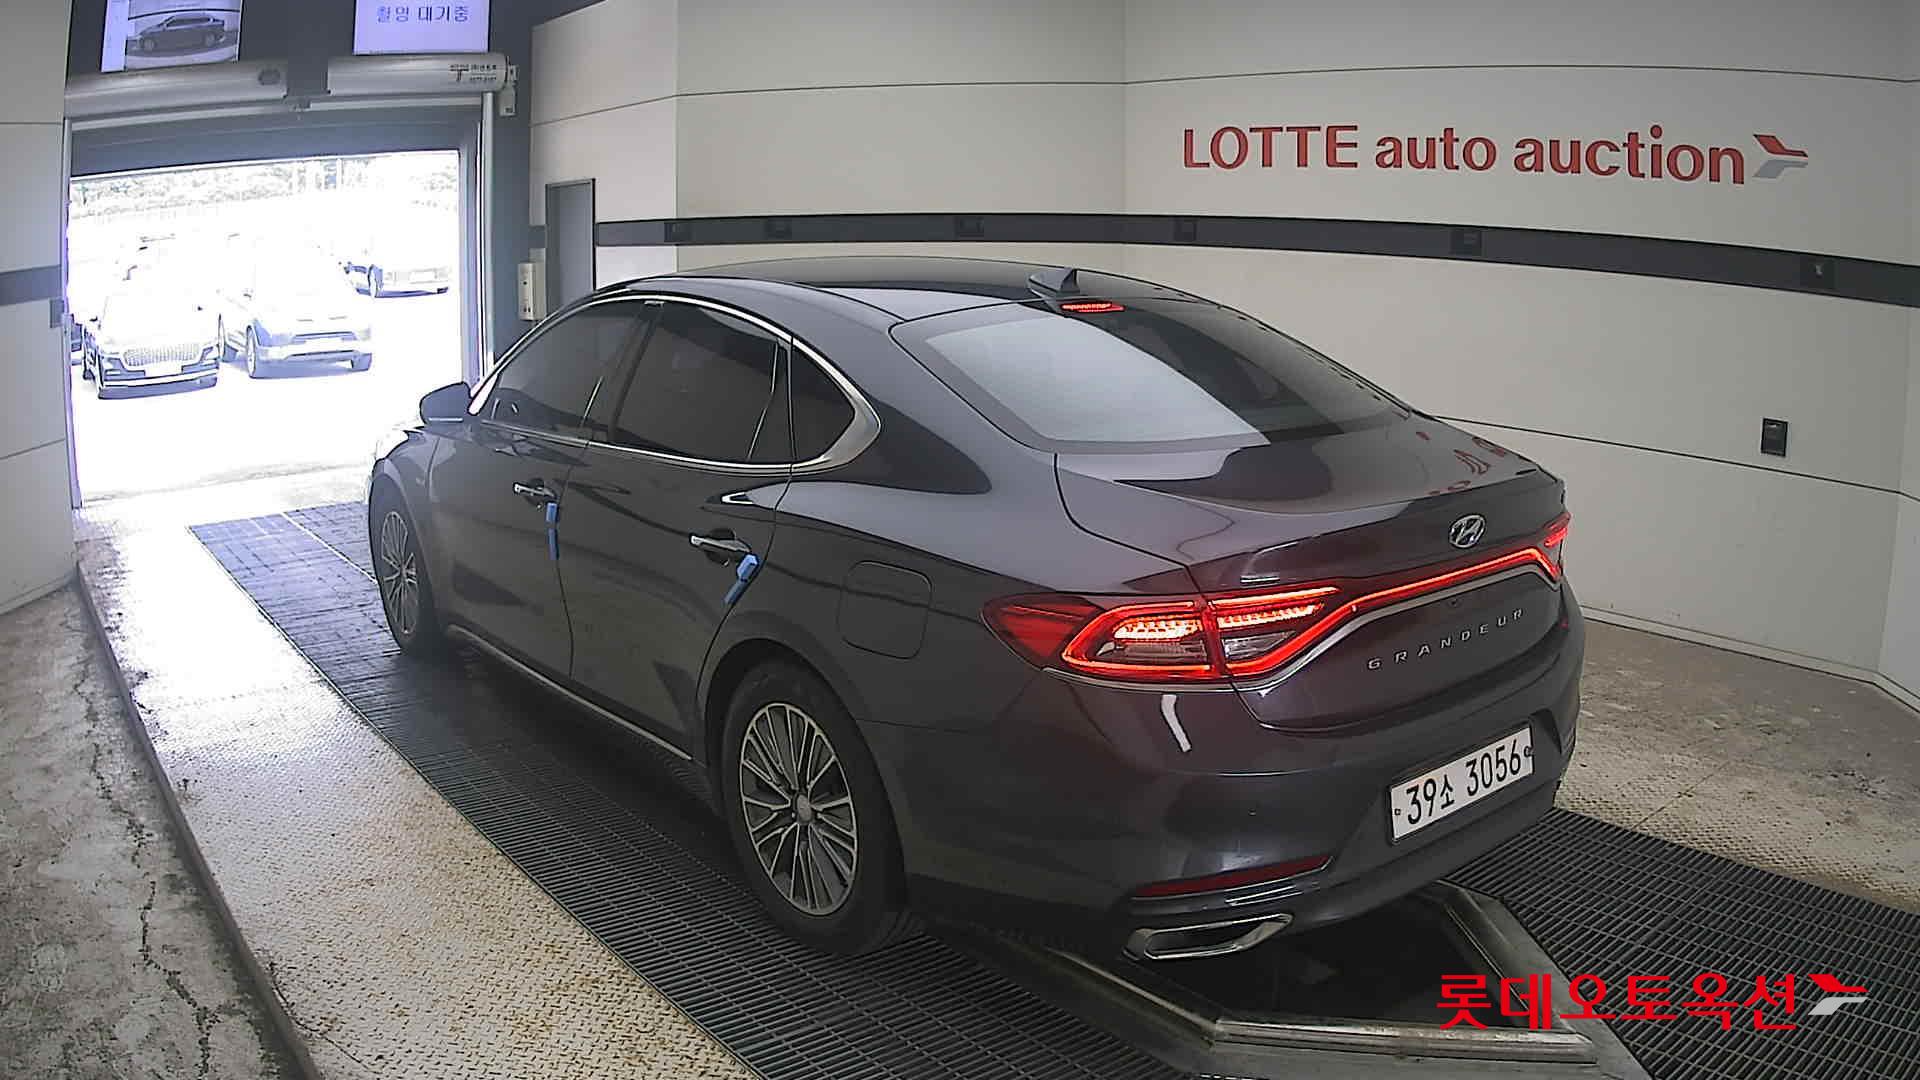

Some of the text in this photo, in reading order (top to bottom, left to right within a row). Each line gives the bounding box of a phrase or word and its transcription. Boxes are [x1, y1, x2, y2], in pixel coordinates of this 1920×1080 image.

[418, 5, 469, 23] 대기중
[1183, 125, 1745, 185] LOTTE auto auction
[1367, 608, 1523, 670] GRANDEUR
[1406, 739, 1522, 825] 39소 3056
